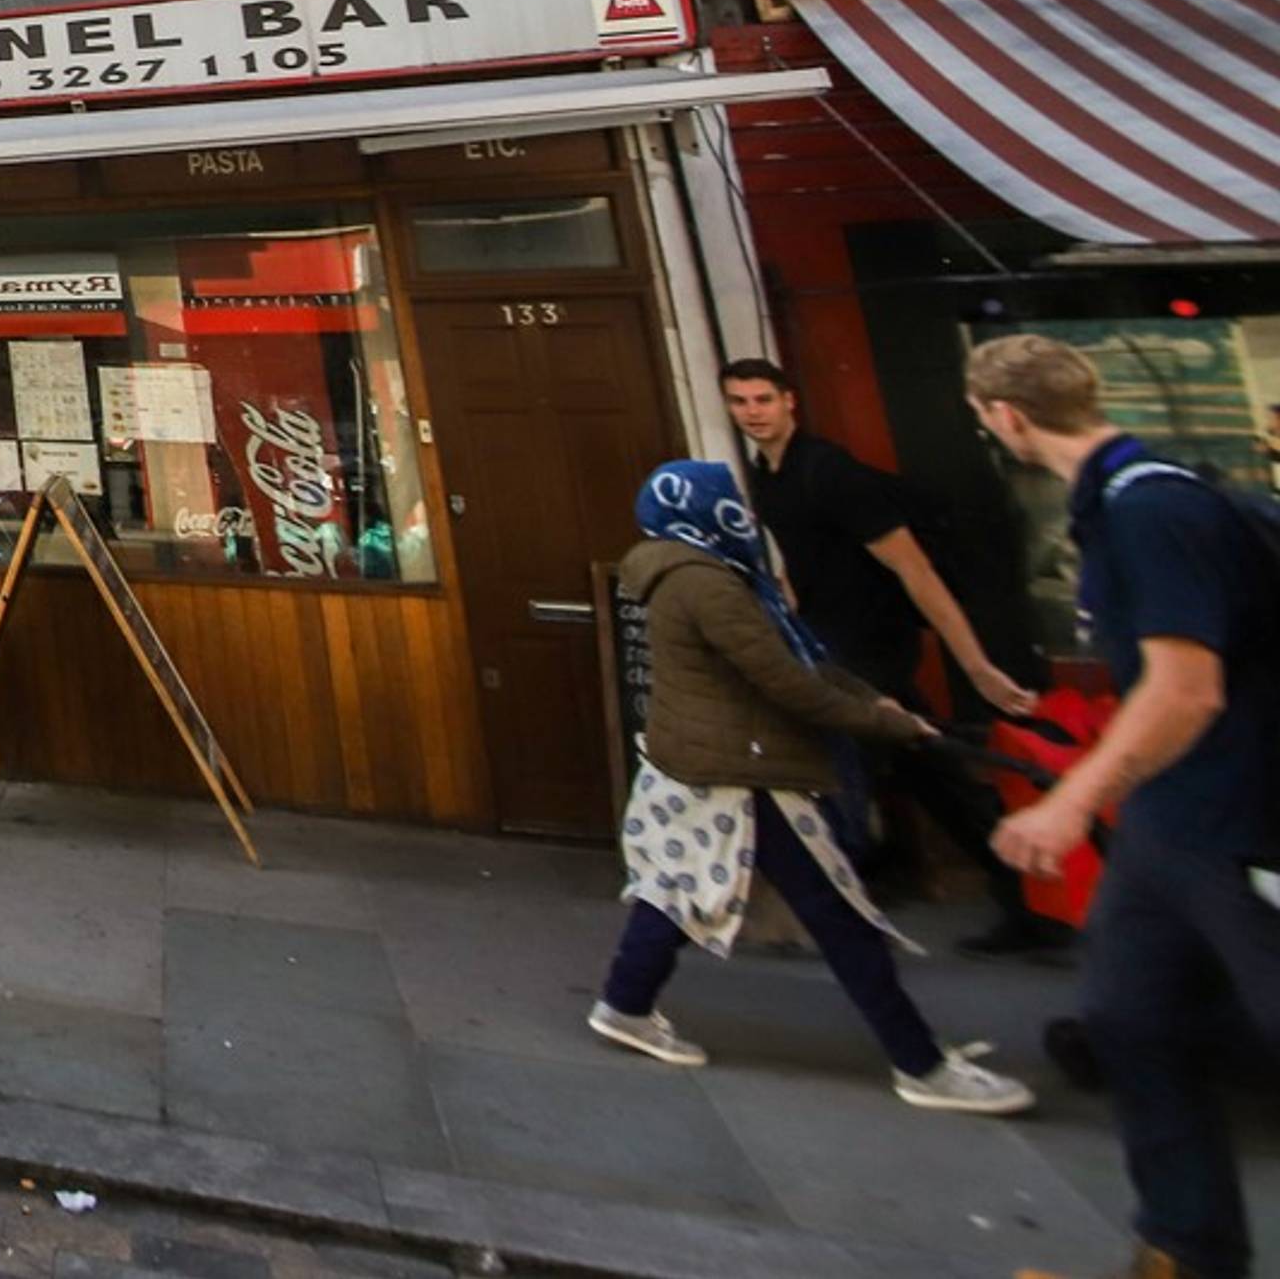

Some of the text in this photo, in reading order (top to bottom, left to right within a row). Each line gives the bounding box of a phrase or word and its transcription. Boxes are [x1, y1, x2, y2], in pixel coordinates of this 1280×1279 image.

[29, 59, 166, 91] 3267
[202, 43, 348, 76] 1105
[188, 149, 264, 175] PASTA
[501, 303, 558, 325] 133
